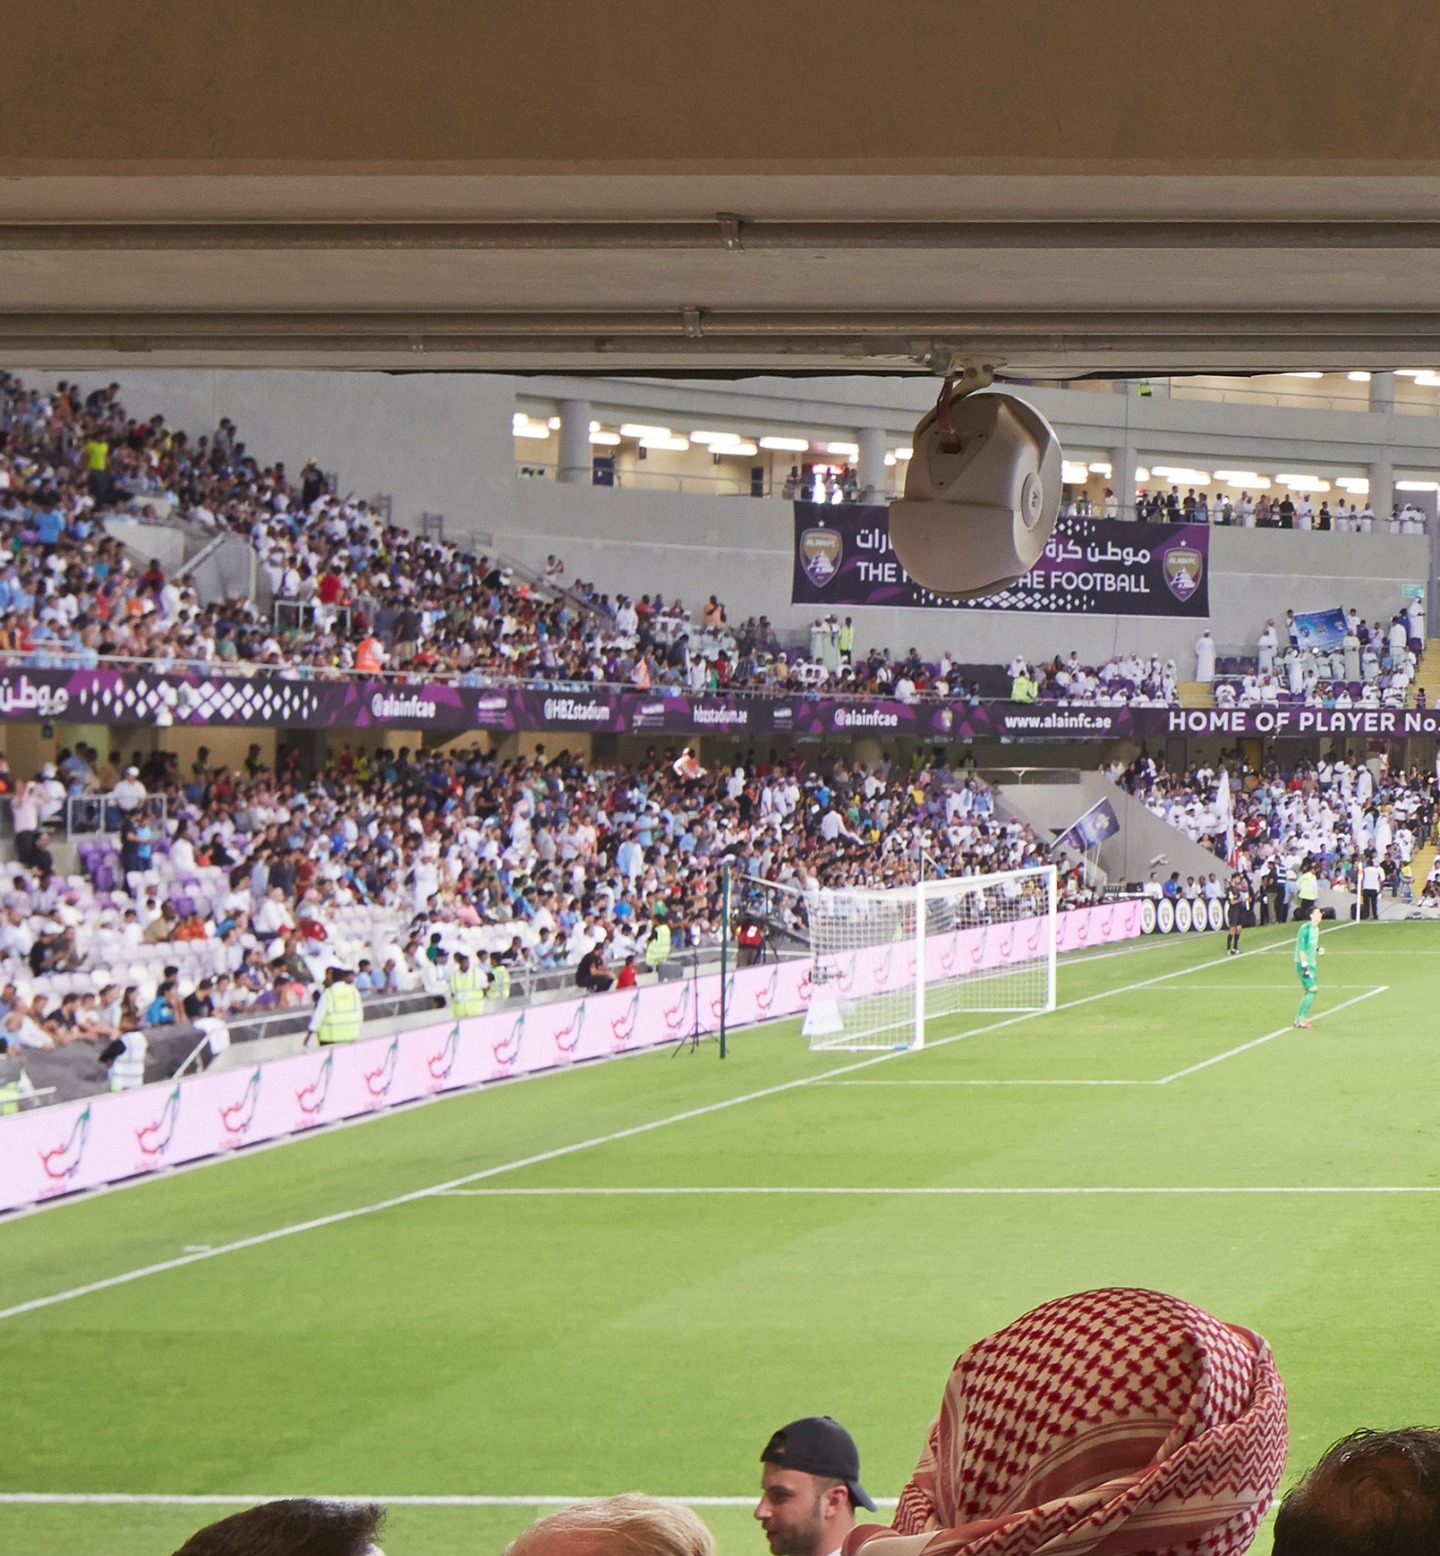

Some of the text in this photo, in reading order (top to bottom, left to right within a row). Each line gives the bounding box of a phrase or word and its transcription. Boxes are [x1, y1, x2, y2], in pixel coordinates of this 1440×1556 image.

[1043, 535, 1151, 566] موطن كرة
[856, 561, 897, 583] THE
[1009, 569, 1045, 589] AE
[1050, 571, 1150, 593] FOOTBALL
[371, 692, 436, 718] @alainfcae
[544, 698, 610, 721] @HBZstadium
[693, 705, 748, 724] hbzstadium.ae
[834, 708, 898, 727] @alainfcae
[1004, 711, 1112, 729] www.alainfc.ae
[1169, 711, 1246, 731] HOME
[1255, 712, 1290, 733] OF
[1299, 712, 1395, 732] PLAYER
